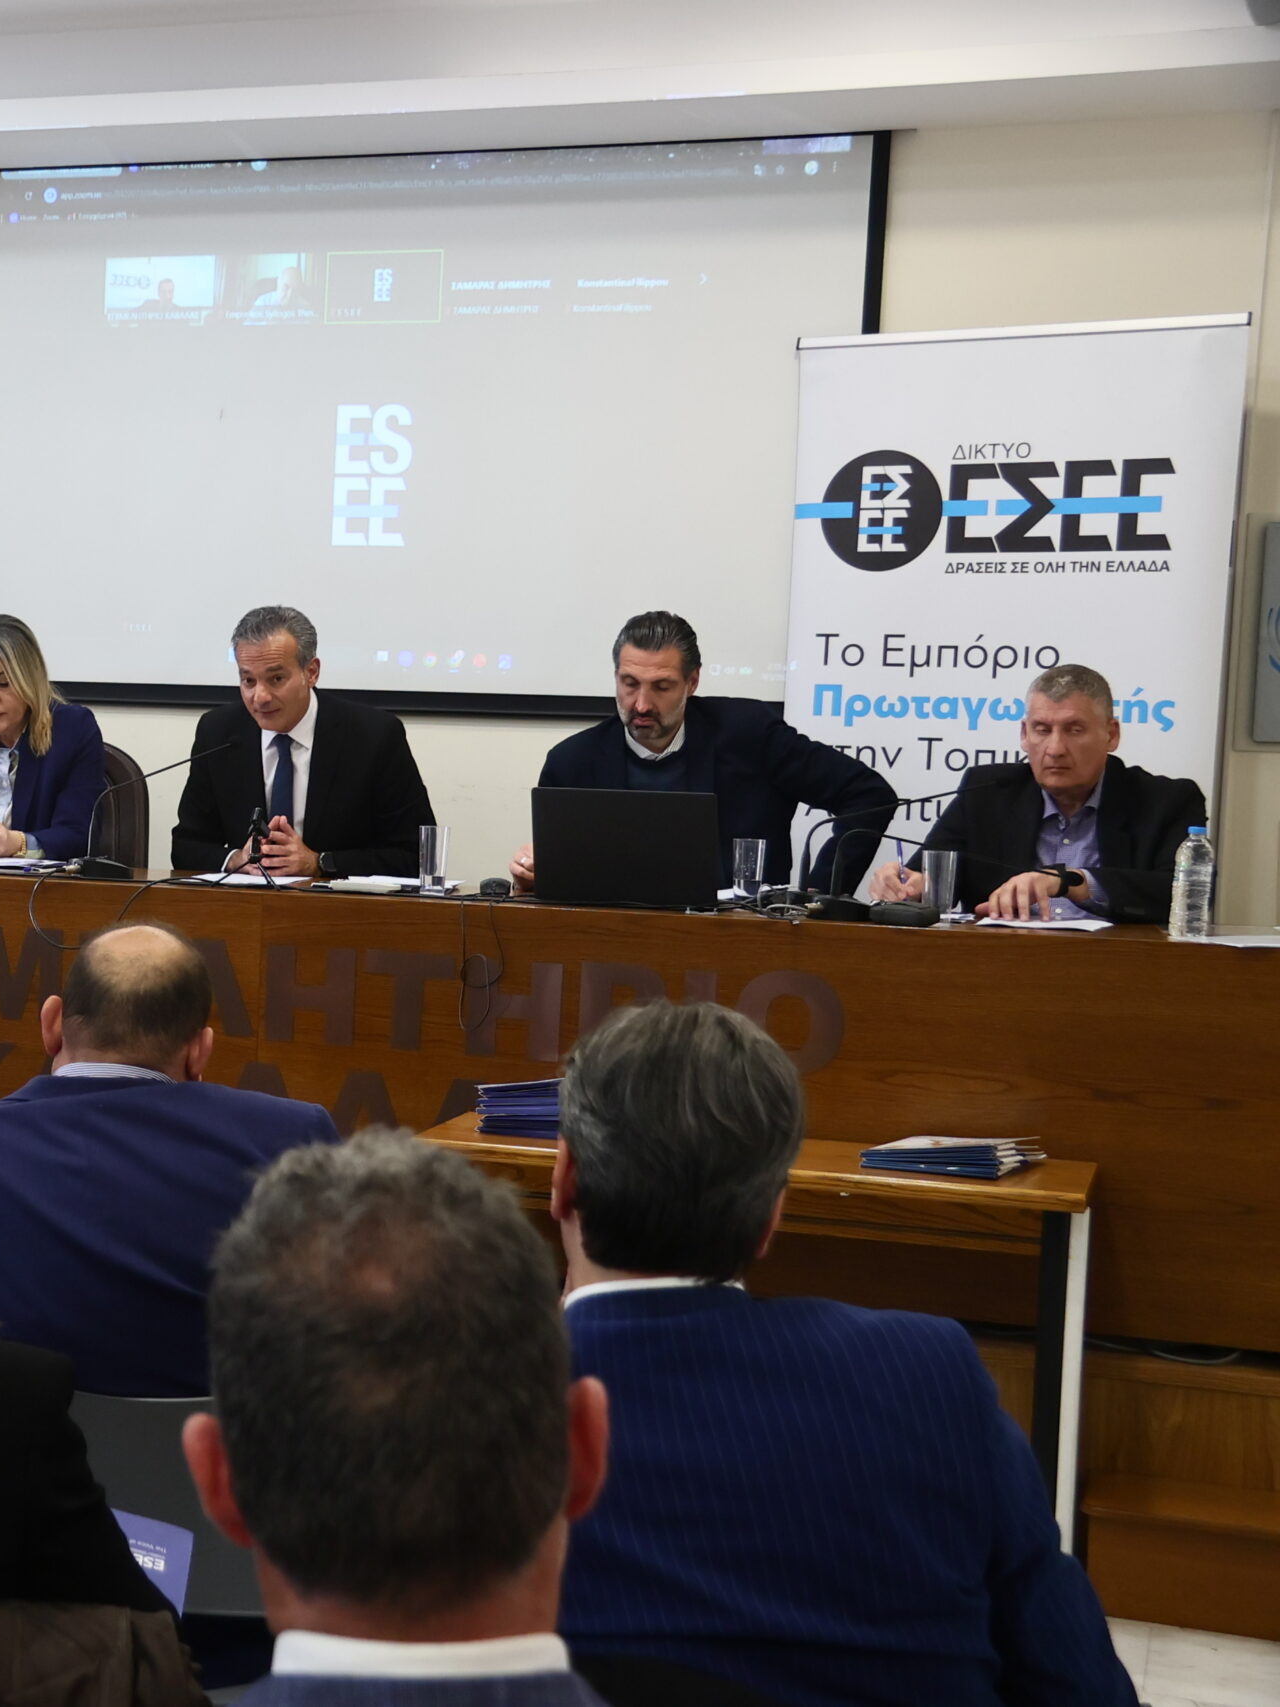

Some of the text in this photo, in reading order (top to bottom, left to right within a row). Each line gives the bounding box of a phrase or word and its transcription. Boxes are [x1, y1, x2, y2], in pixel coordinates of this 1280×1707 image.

[334, 404, 414, 475] ES
[951, 442, 1031, 460] ΔΙΚΤΥΟ
[331, 477, 407, 547] EE
[944, 560, 1170, 574] ΔΡΑΣΕΙΣ ΣΕ ΟΛΗ ΤΗΝ ΕΛΛΑΔΑ
[816, 633, 1060, 678] Το Εμπόριο
